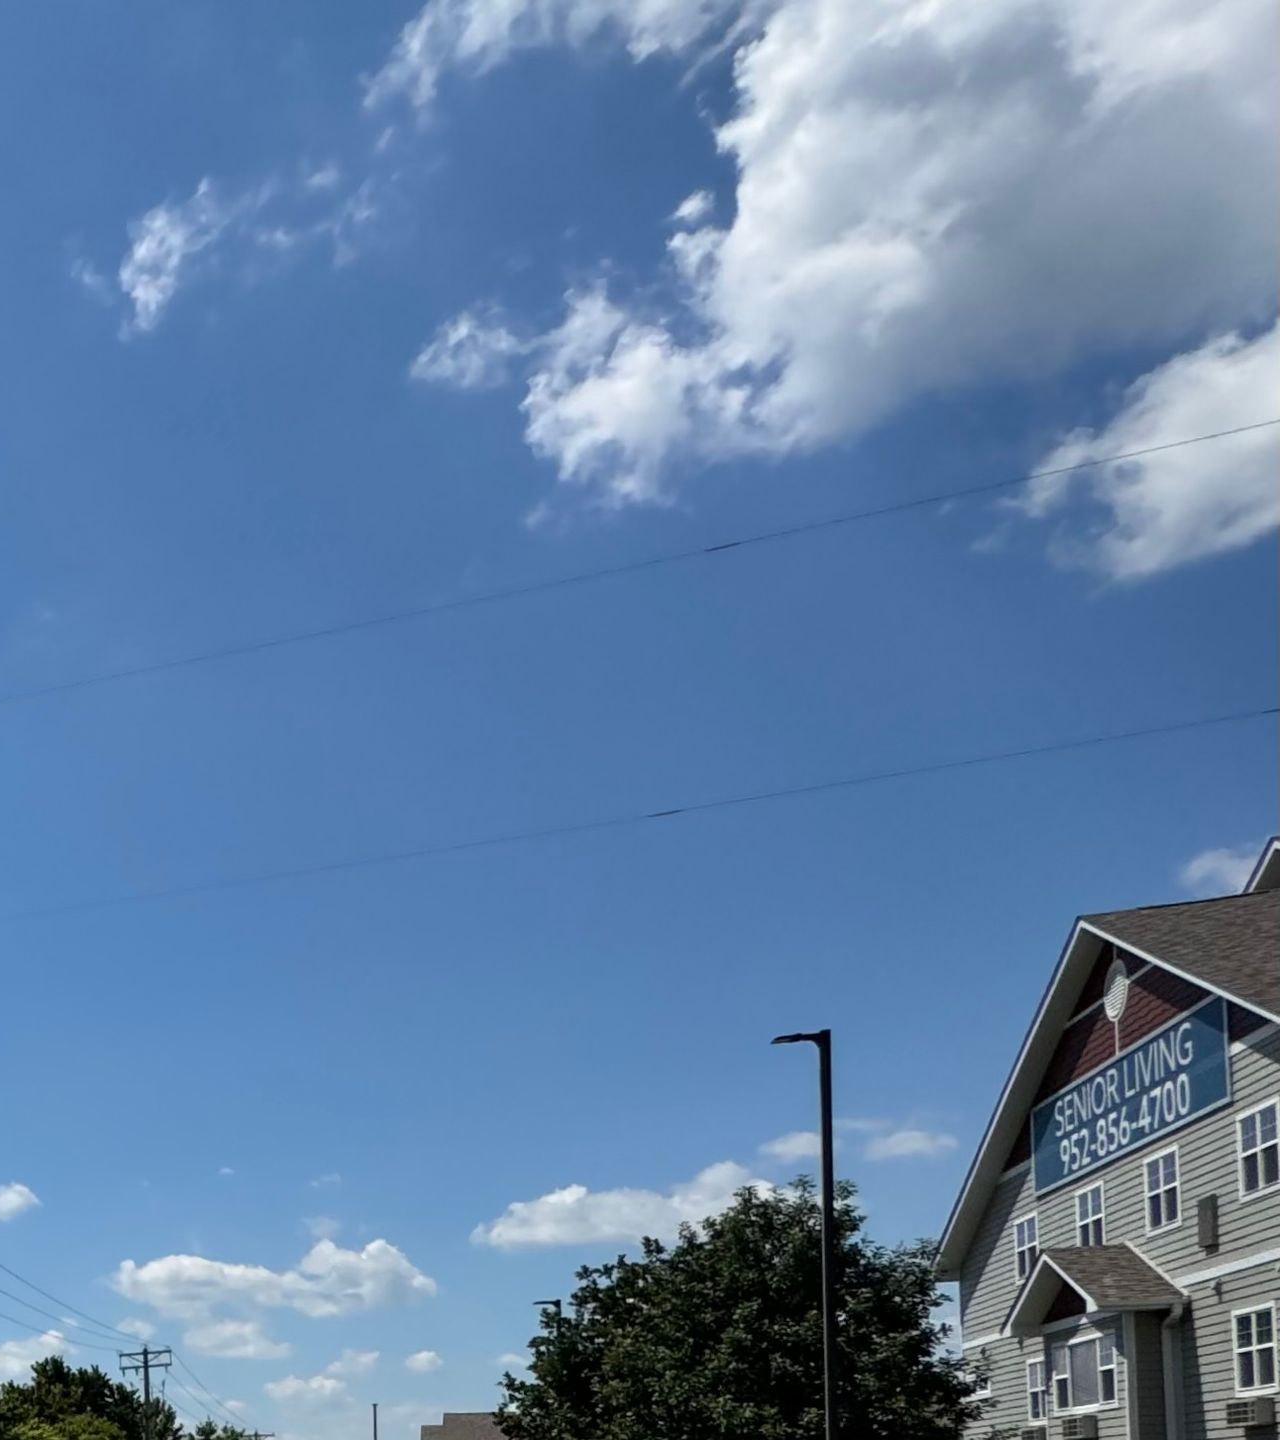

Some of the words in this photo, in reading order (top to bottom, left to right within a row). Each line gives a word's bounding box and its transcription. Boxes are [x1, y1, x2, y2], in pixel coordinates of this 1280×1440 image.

[1054, 1067, 1121, 1137] SENIOR
[1123, 1022, 1193, 1098] LIVING
[1059, 1073, 1190, 1175] 952-856-4700
